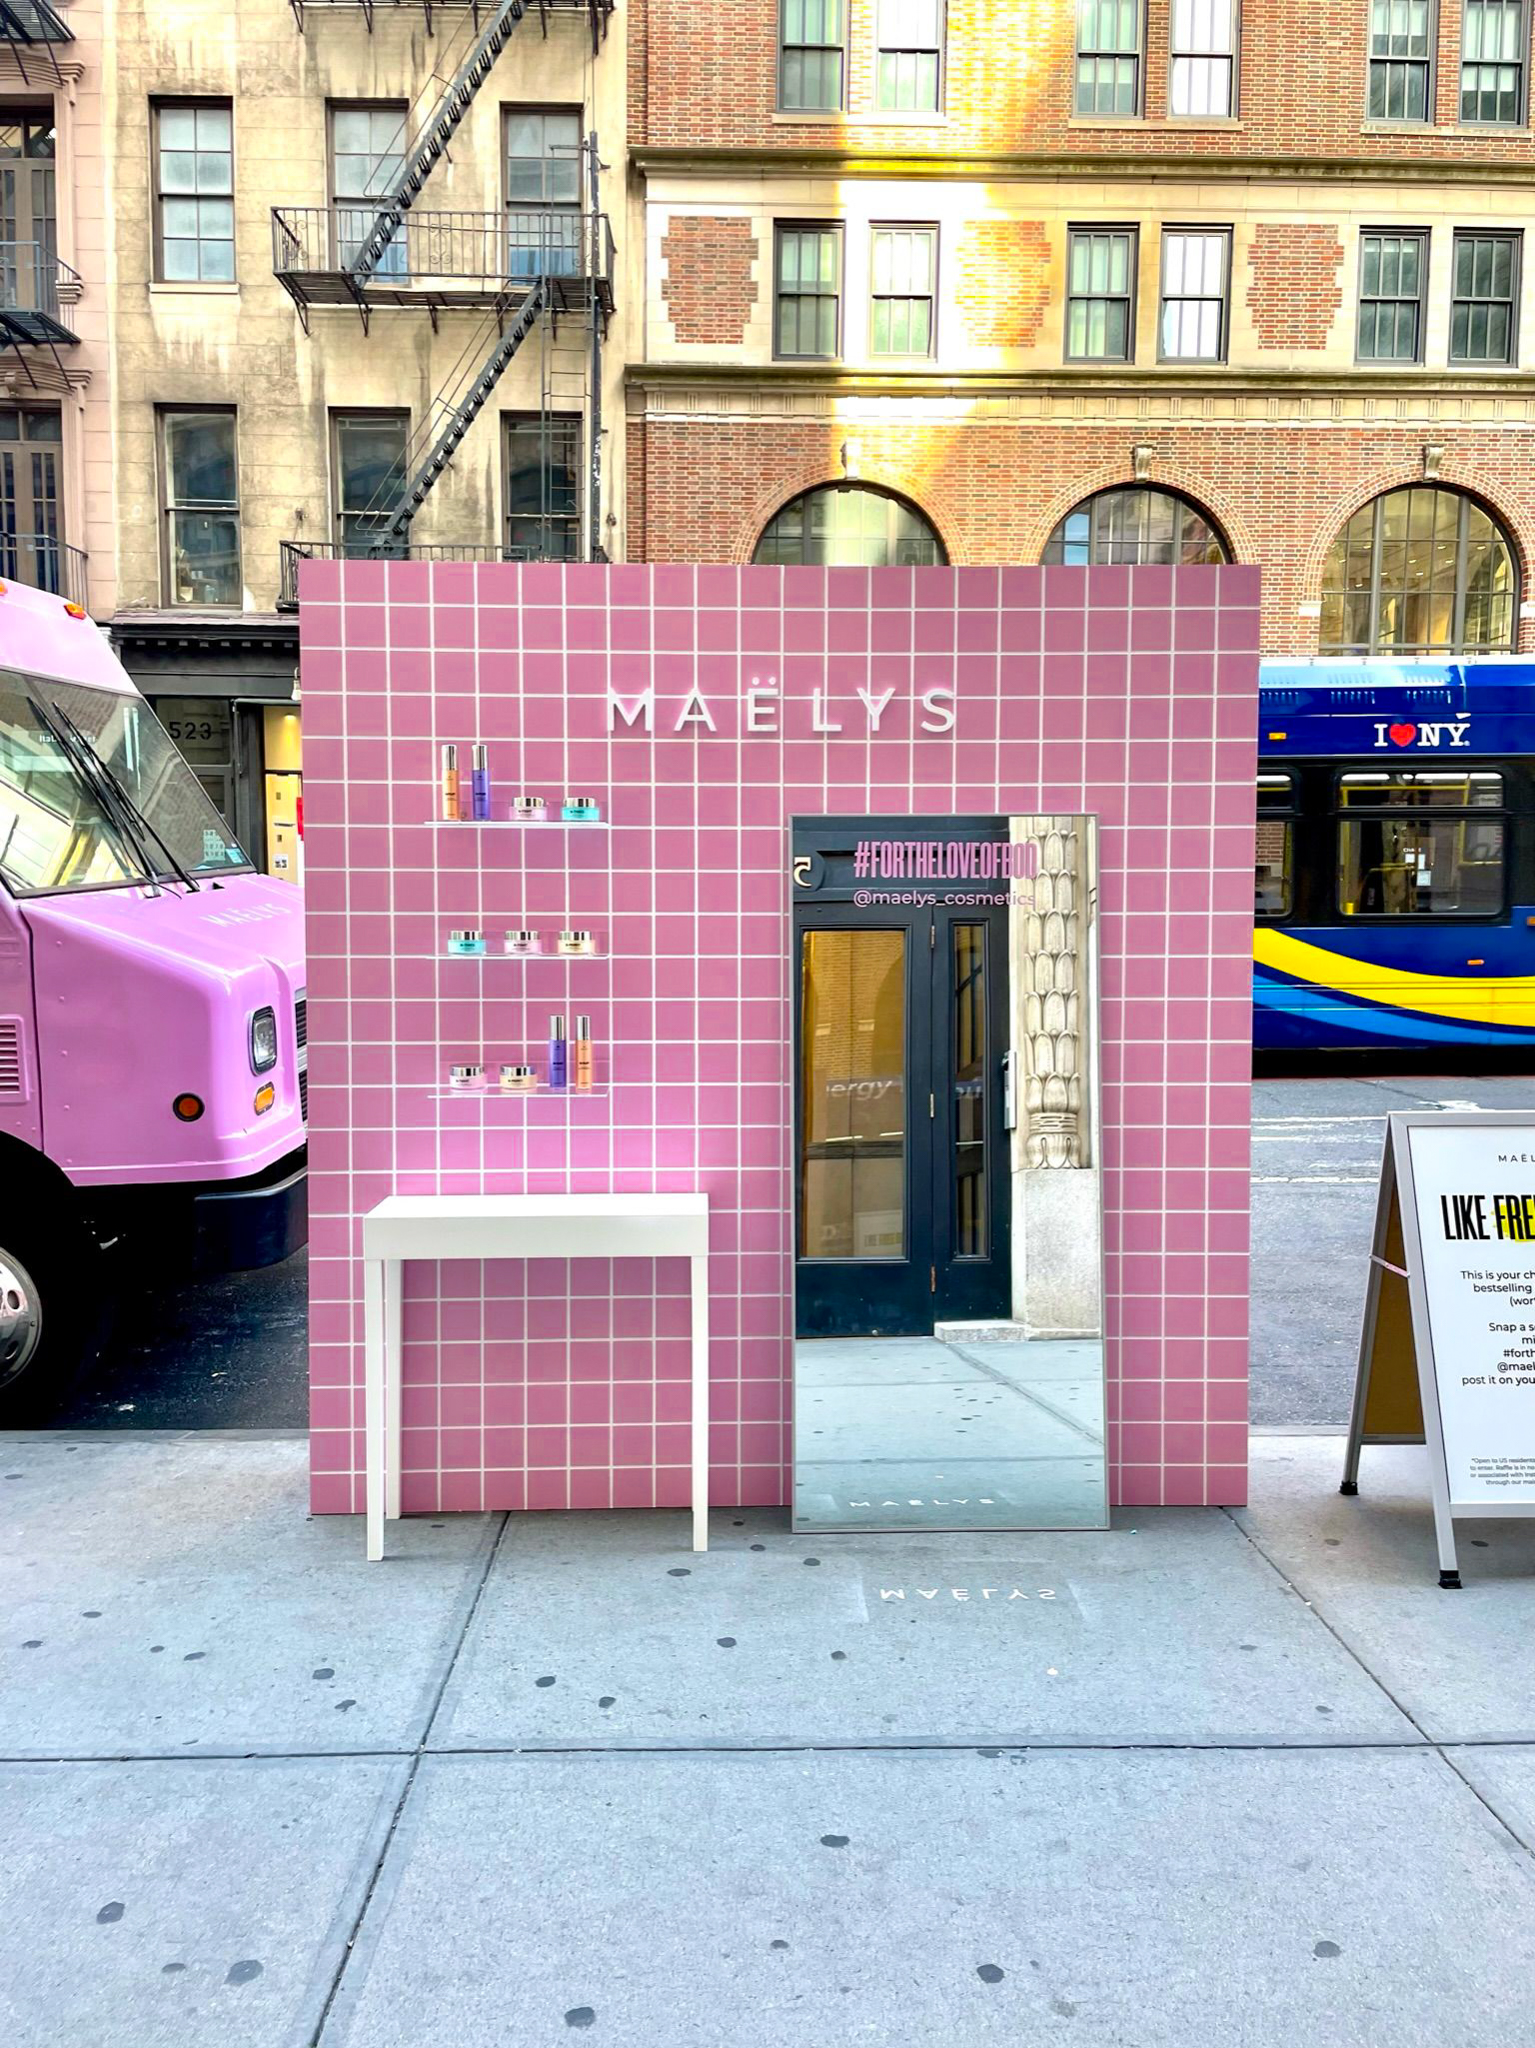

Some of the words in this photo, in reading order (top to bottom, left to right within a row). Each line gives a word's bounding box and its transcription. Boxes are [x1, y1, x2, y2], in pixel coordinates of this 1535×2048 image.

[607, 677, 954, 732] MAËLYS
[169, 722, 212, 740] 523
[1374, 724, 1388, 746] I
[853, 889, 1036, 908] @maelys_cosmetics
[1440, 1195, 1490, 1240] LIKE
[1493, 1195, 1535, 1240] FRE
[1460, 1270, 1483, 1280] This
[1485, 1270, 1494, 1280] is
[1496, 1271, 1521, 1282] your
[1473, 1283, 1532, 1294] bestselling
[1488, 1322, 1517, 1333] Snap
[1462, 1376, 1486, 1386] post
[1488, 1375, 1496, 1384] it
